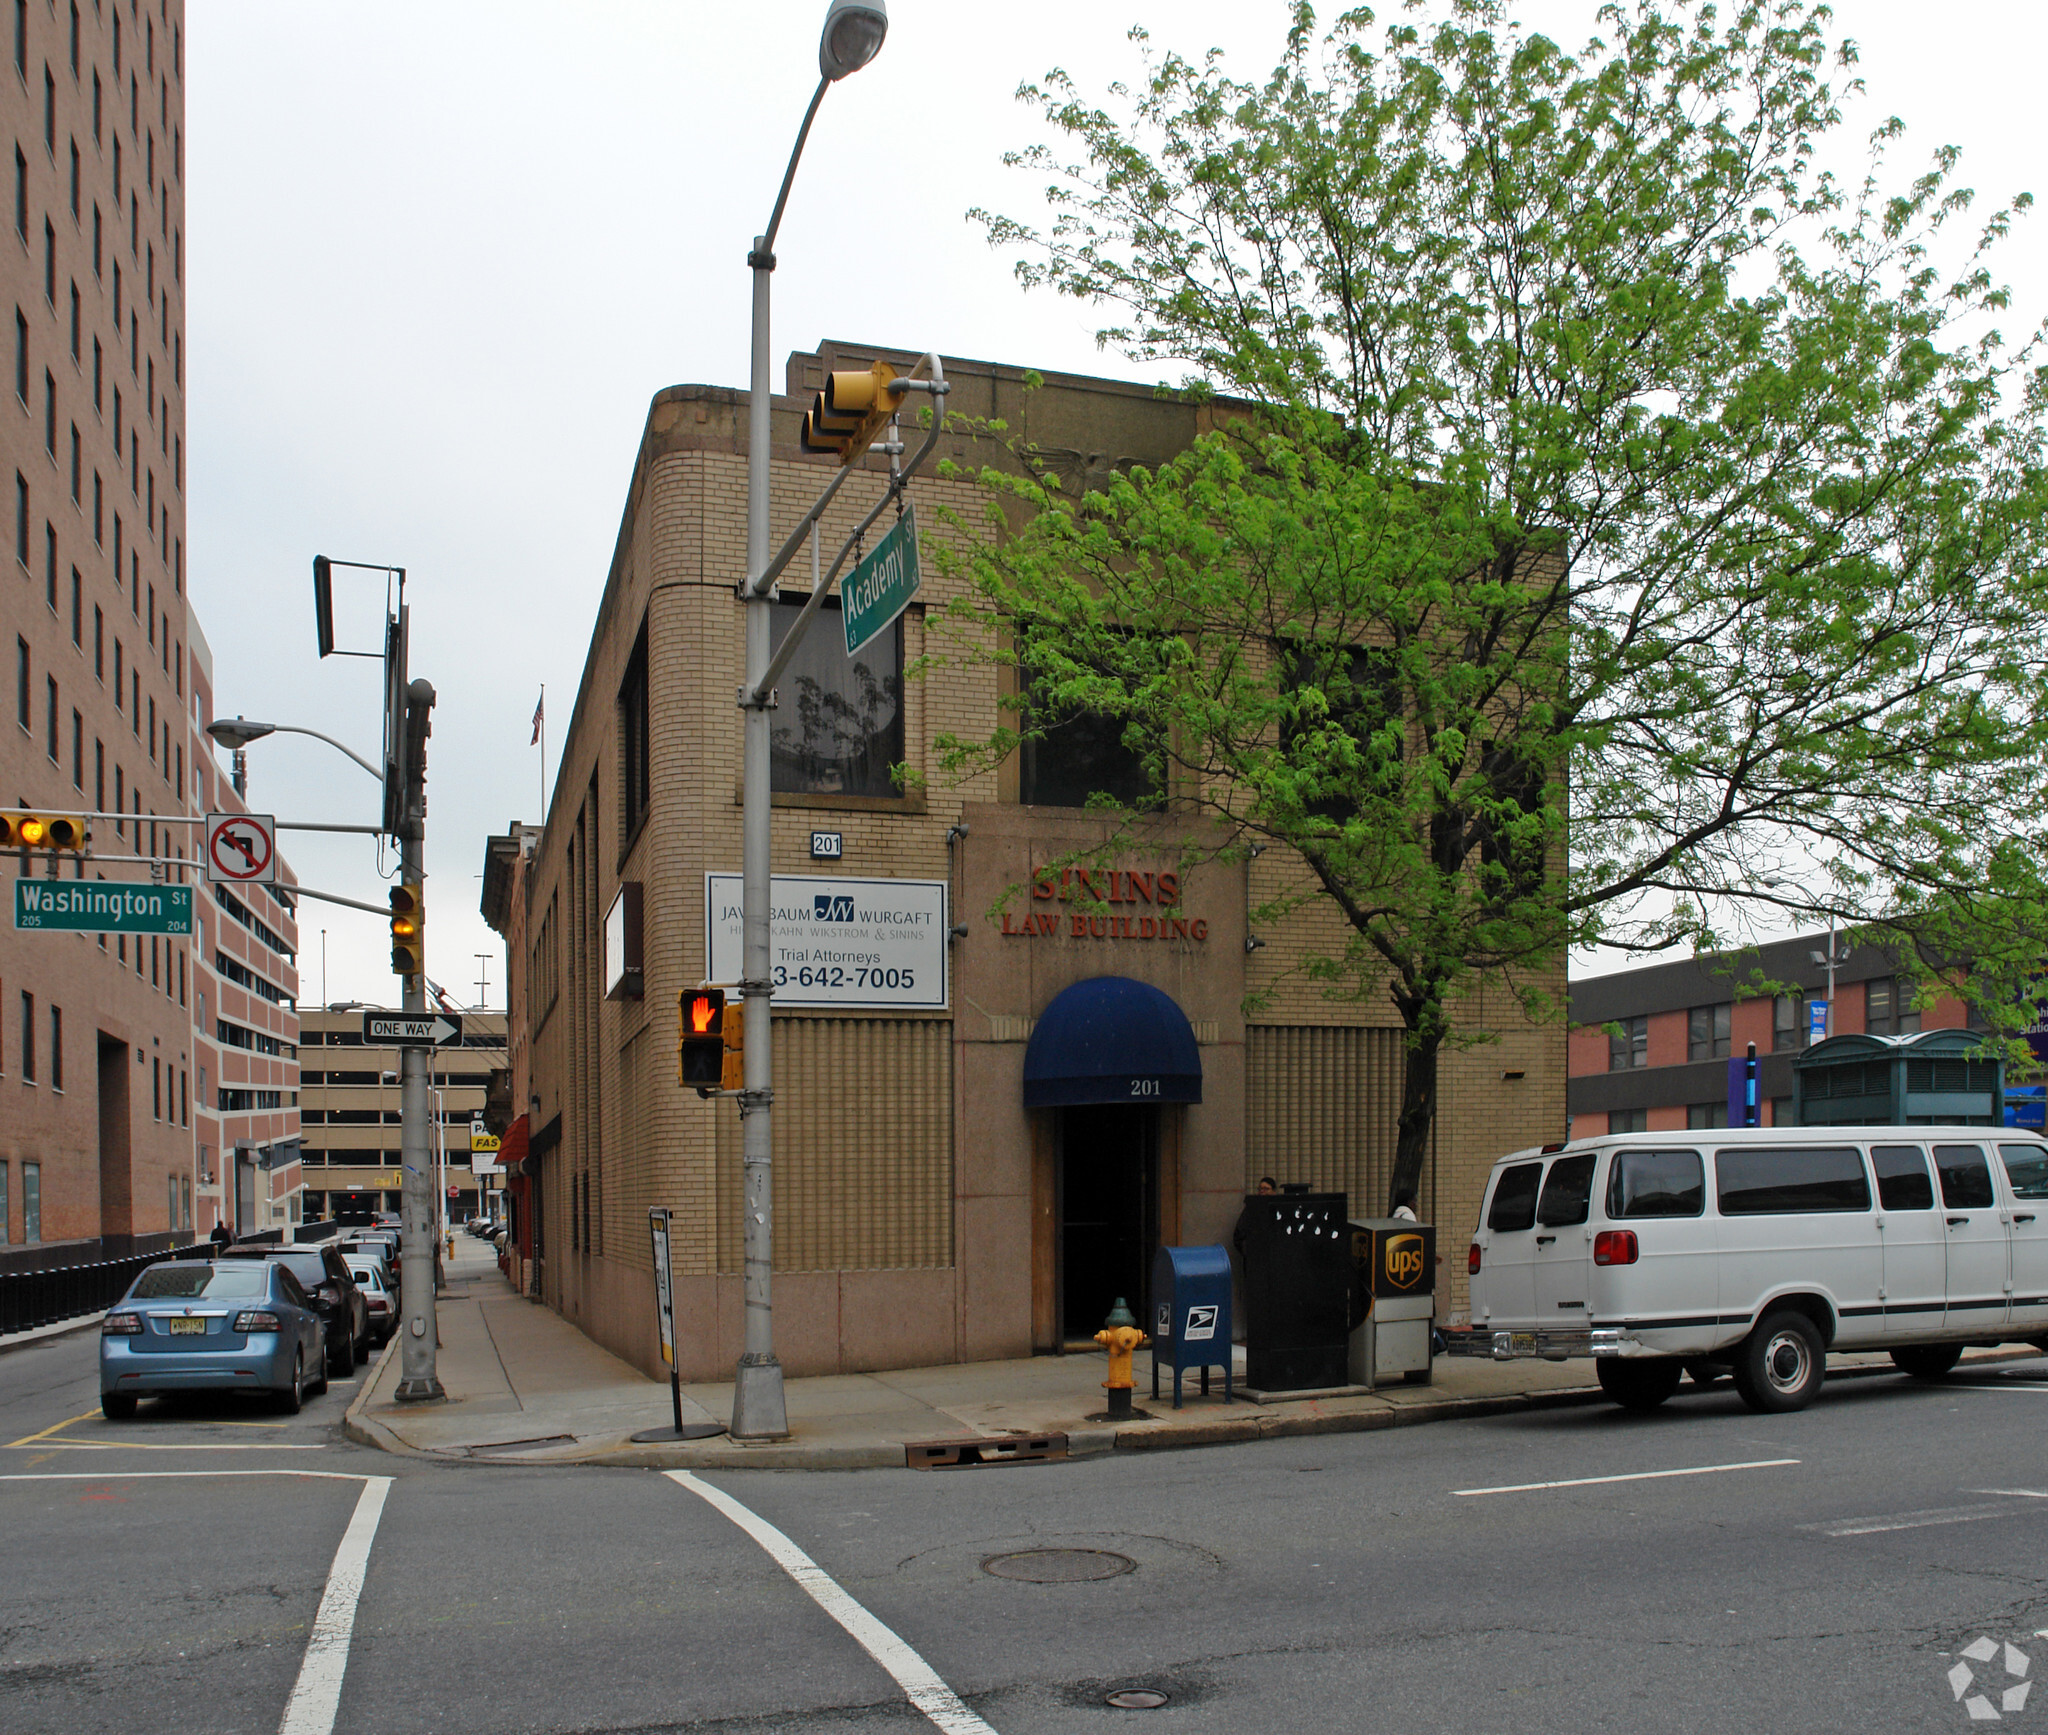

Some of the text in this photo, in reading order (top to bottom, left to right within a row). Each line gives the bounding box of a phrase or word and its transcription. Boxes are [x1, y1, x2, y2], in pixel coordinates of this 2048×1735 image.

[848, 518, 914, 625] Academy St
[815, 836, 839, 853] 201
[1032, 866, 1181, 905] SININS
[22, 885, 188, 922] Washington St
[22, 915, 188, 932] 205 204
[721, 905, 810, 921] JAVBAUM
[859, 910, 933, 925] WURGAFT
[771, 926, 803, 937] KAHN
[810, 927, 869, 939] WIKSTROM
[874, 928, 886, 941] &
[889, 929, 925, 940] SININS
[1000, 912, 1209, 941] LAW BUILDING
[778, 948, 881, 967] Trial Attorneys
[742, 965, 915, 989] 3-642-7005
[374, 1022, 433, 1036] ONE WAY
[1131, 1079, 1161, 1096] 201
[475, 1138, 499, 1148] FAS
[1388, 1250, 1421, 1281] ups
